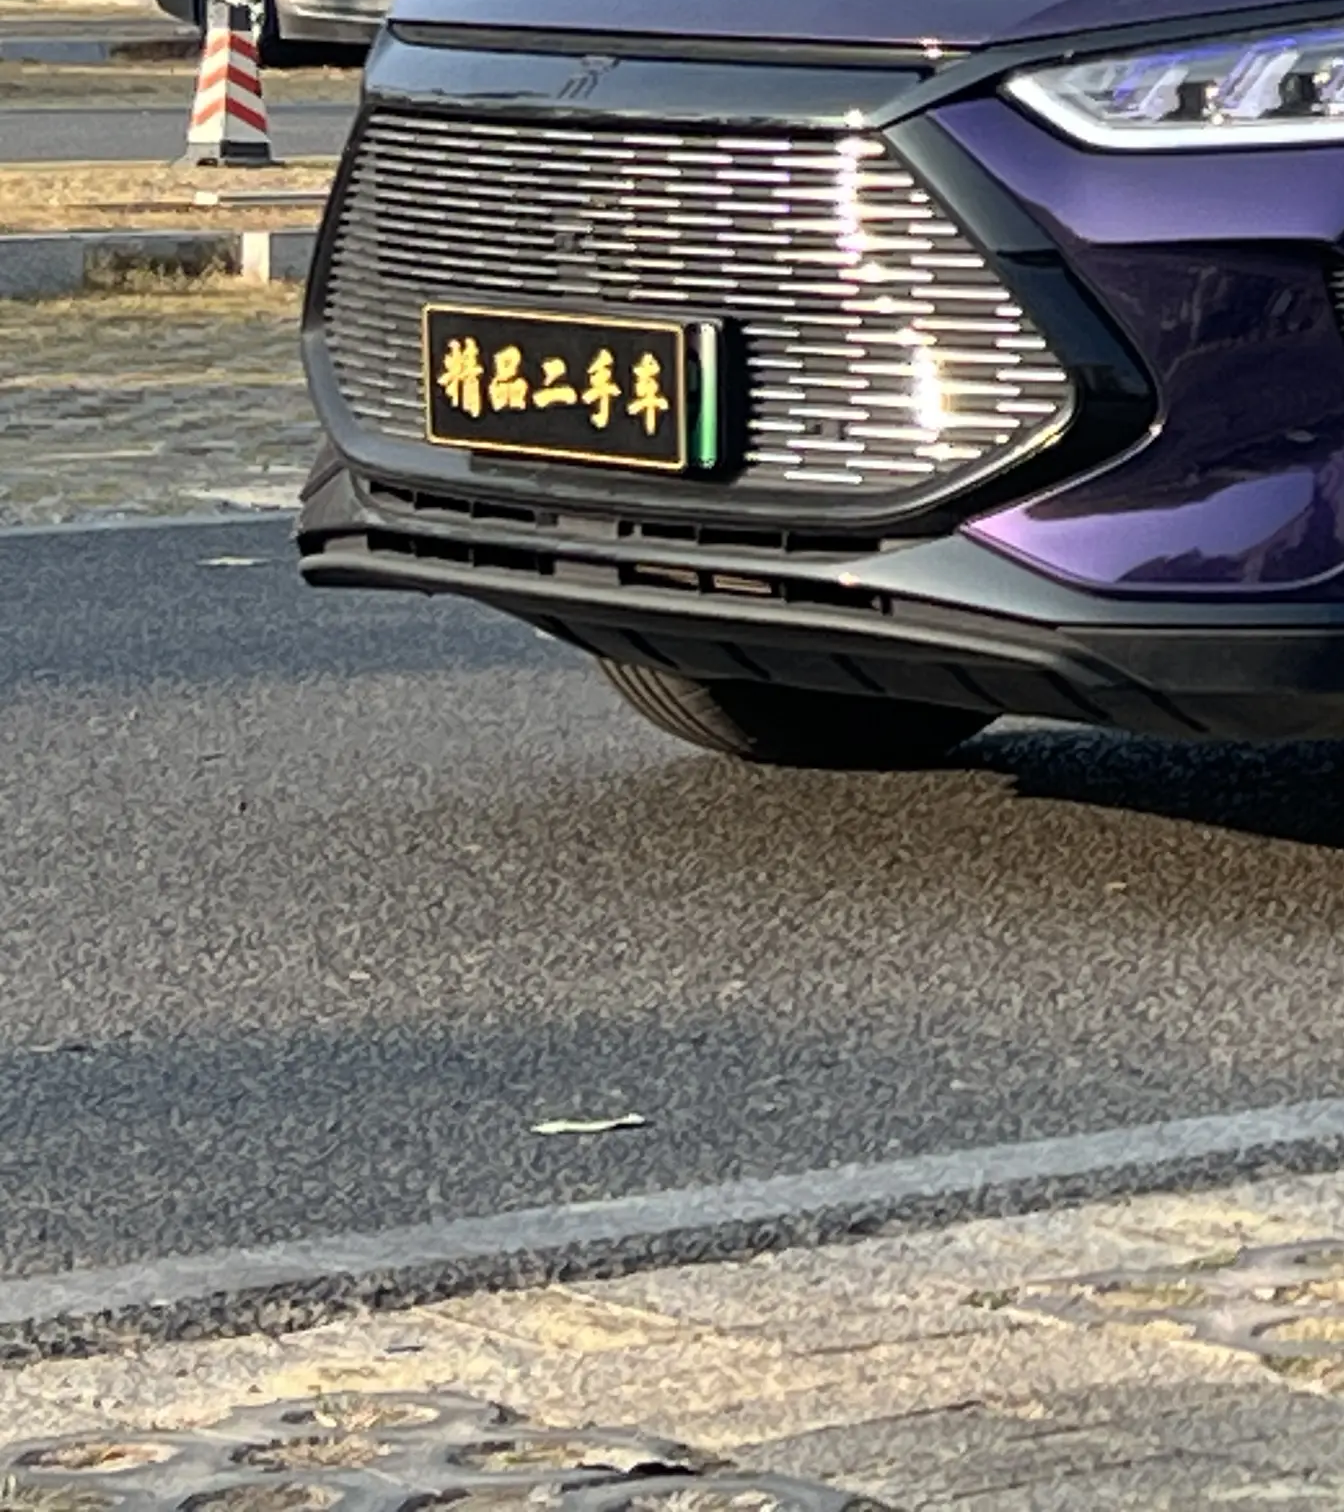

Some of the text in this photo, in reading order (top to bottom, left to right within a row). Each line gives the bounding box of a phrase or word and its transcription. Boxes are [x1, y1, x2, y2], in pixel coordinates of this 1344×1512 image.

[438, 337, 669, 434] 精品二手车
